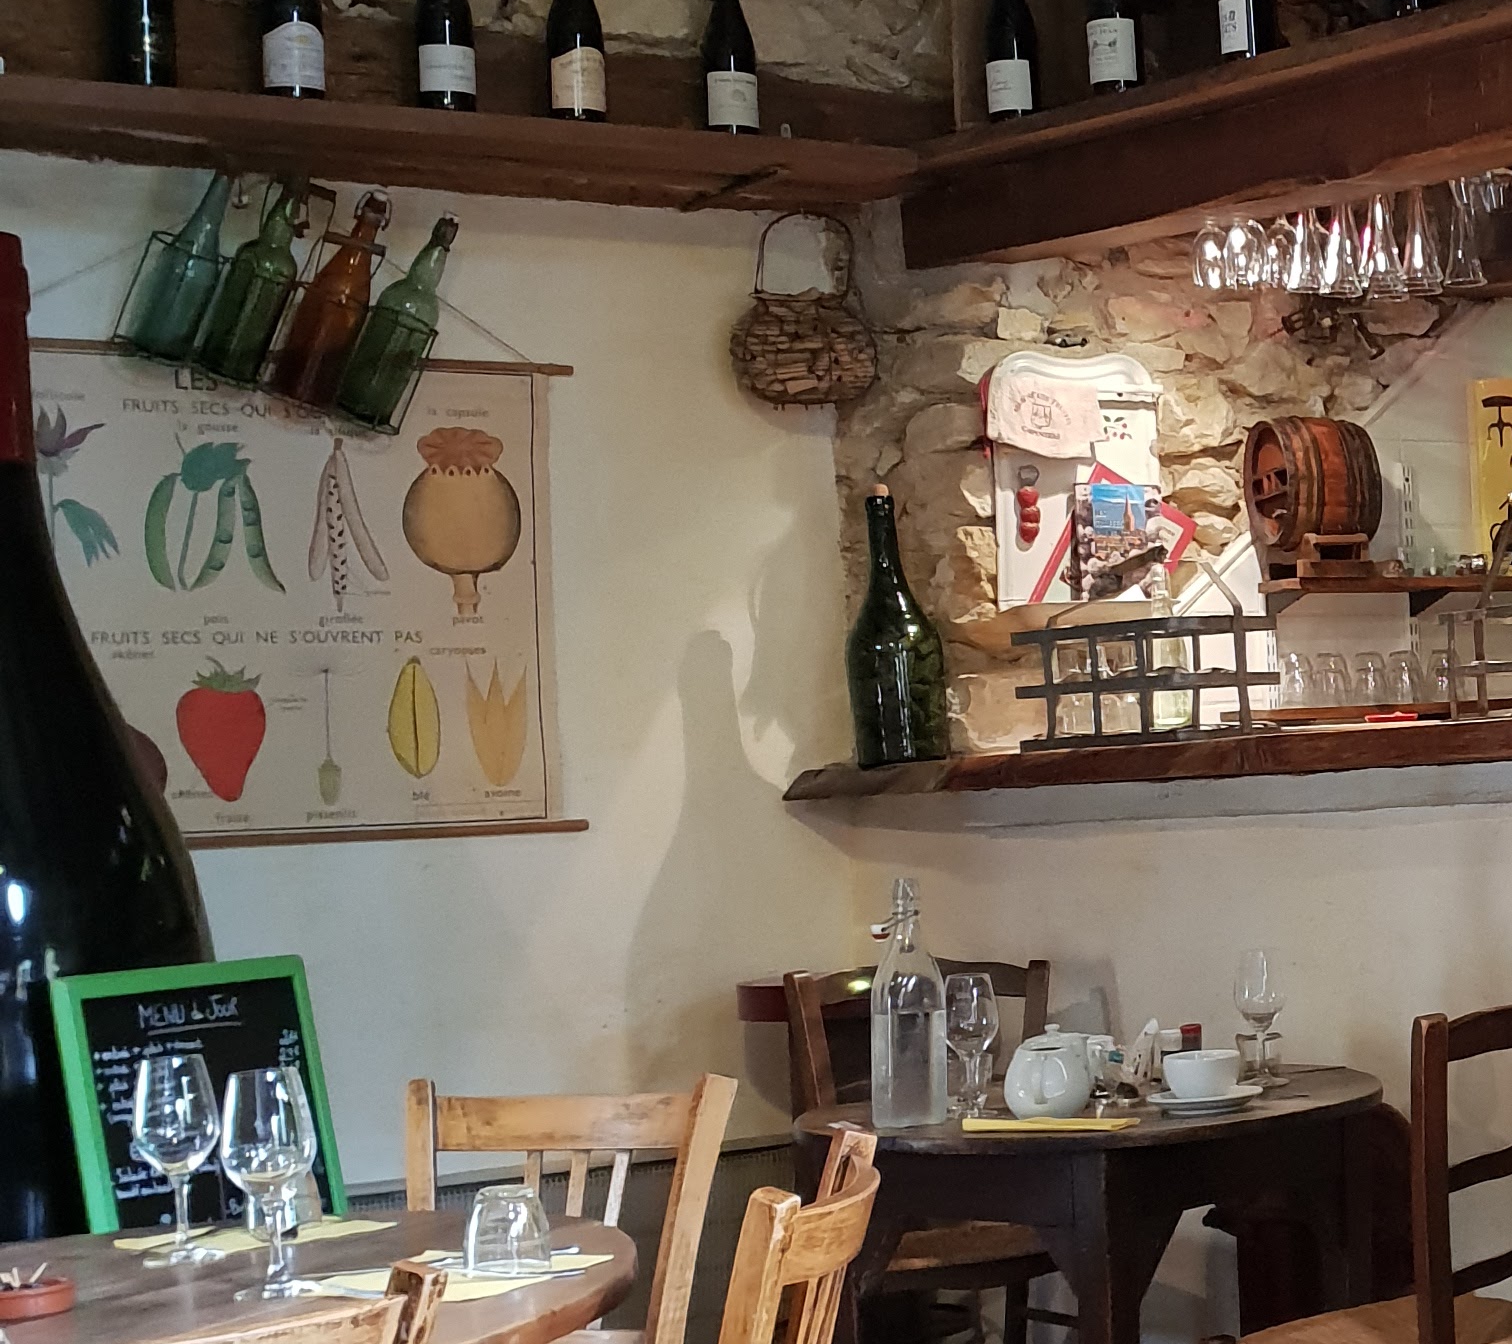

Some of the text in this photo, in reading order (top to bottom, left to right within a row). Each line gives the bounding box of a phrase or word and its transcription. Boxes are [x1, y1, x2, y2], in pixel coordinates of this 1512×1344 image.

[122, 398, 179, 416] FRUITS
[190, 399, 231, 417] SECS
[91, 629, 423, 645] FRUITS SECS QUI NE S'OUVRENT PAS
